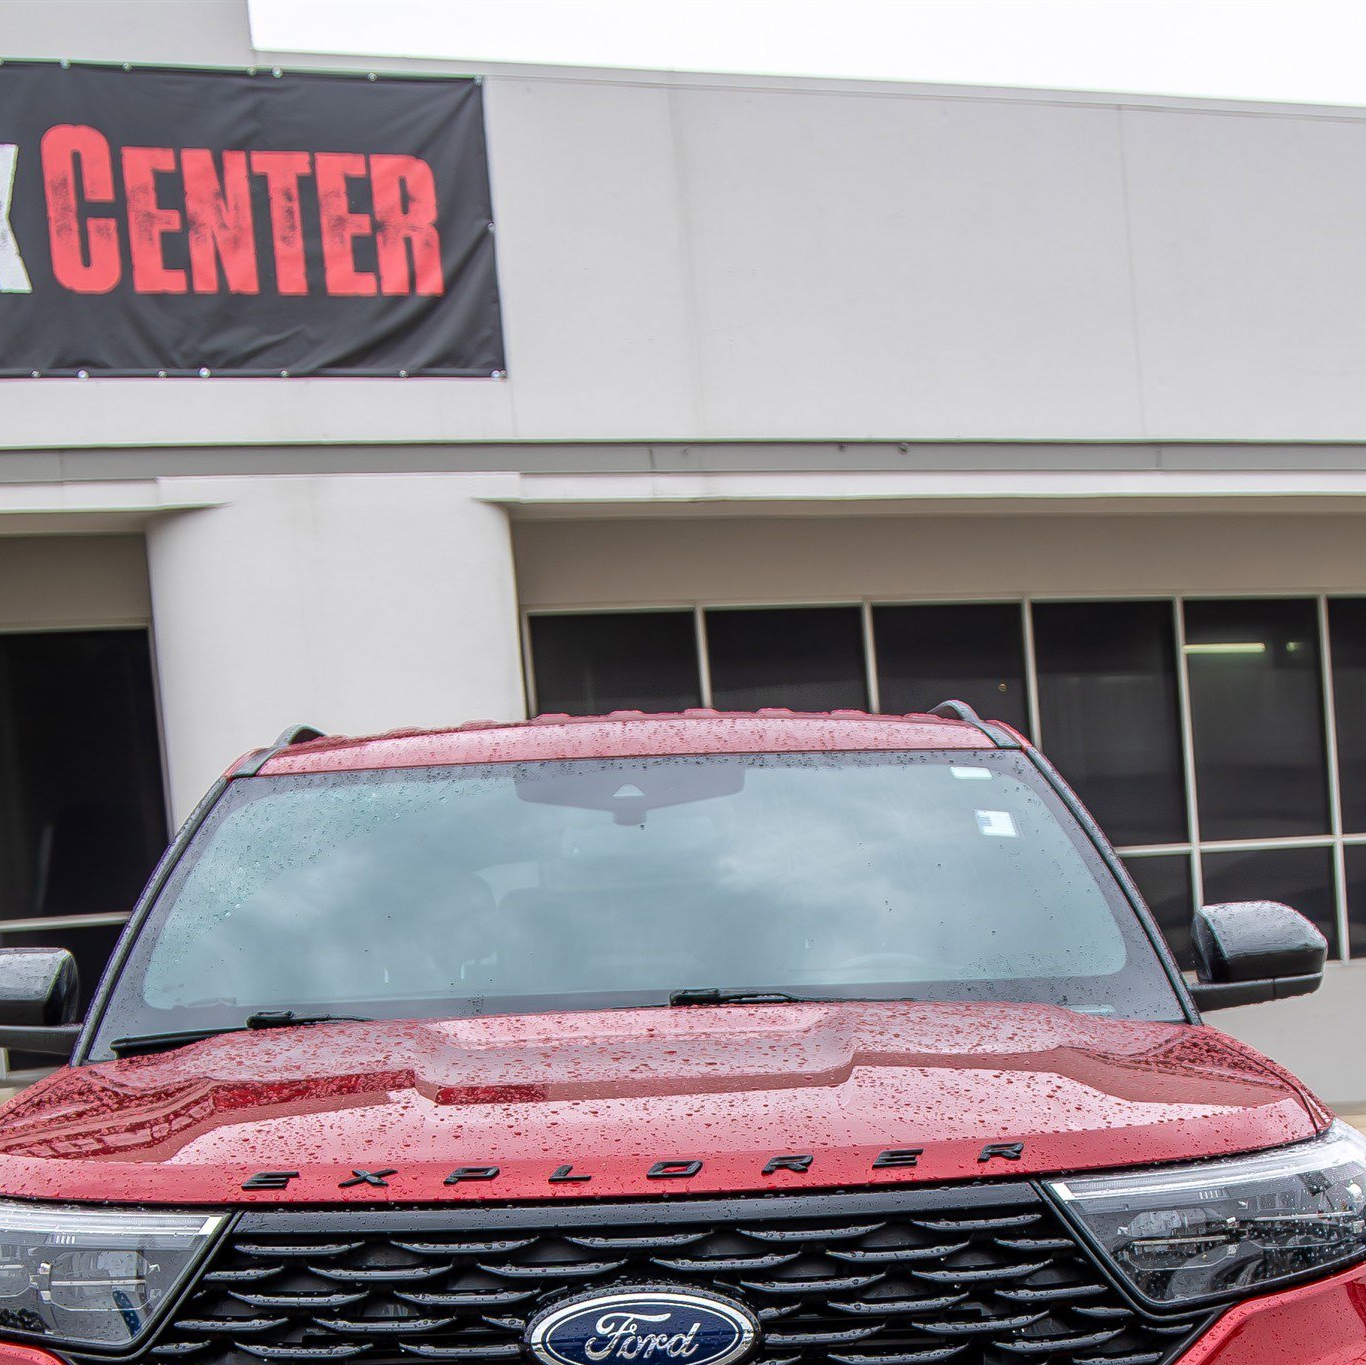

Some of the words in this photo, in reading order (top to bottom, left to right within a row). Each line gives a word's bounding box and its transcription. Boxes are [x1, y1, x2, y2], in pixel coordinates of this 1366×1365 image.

[39, 122, 446, 297] CENTER
[241, 1141, 1025, 1191] EXPLORER
[585, 1312, 701, 1361] Ford
